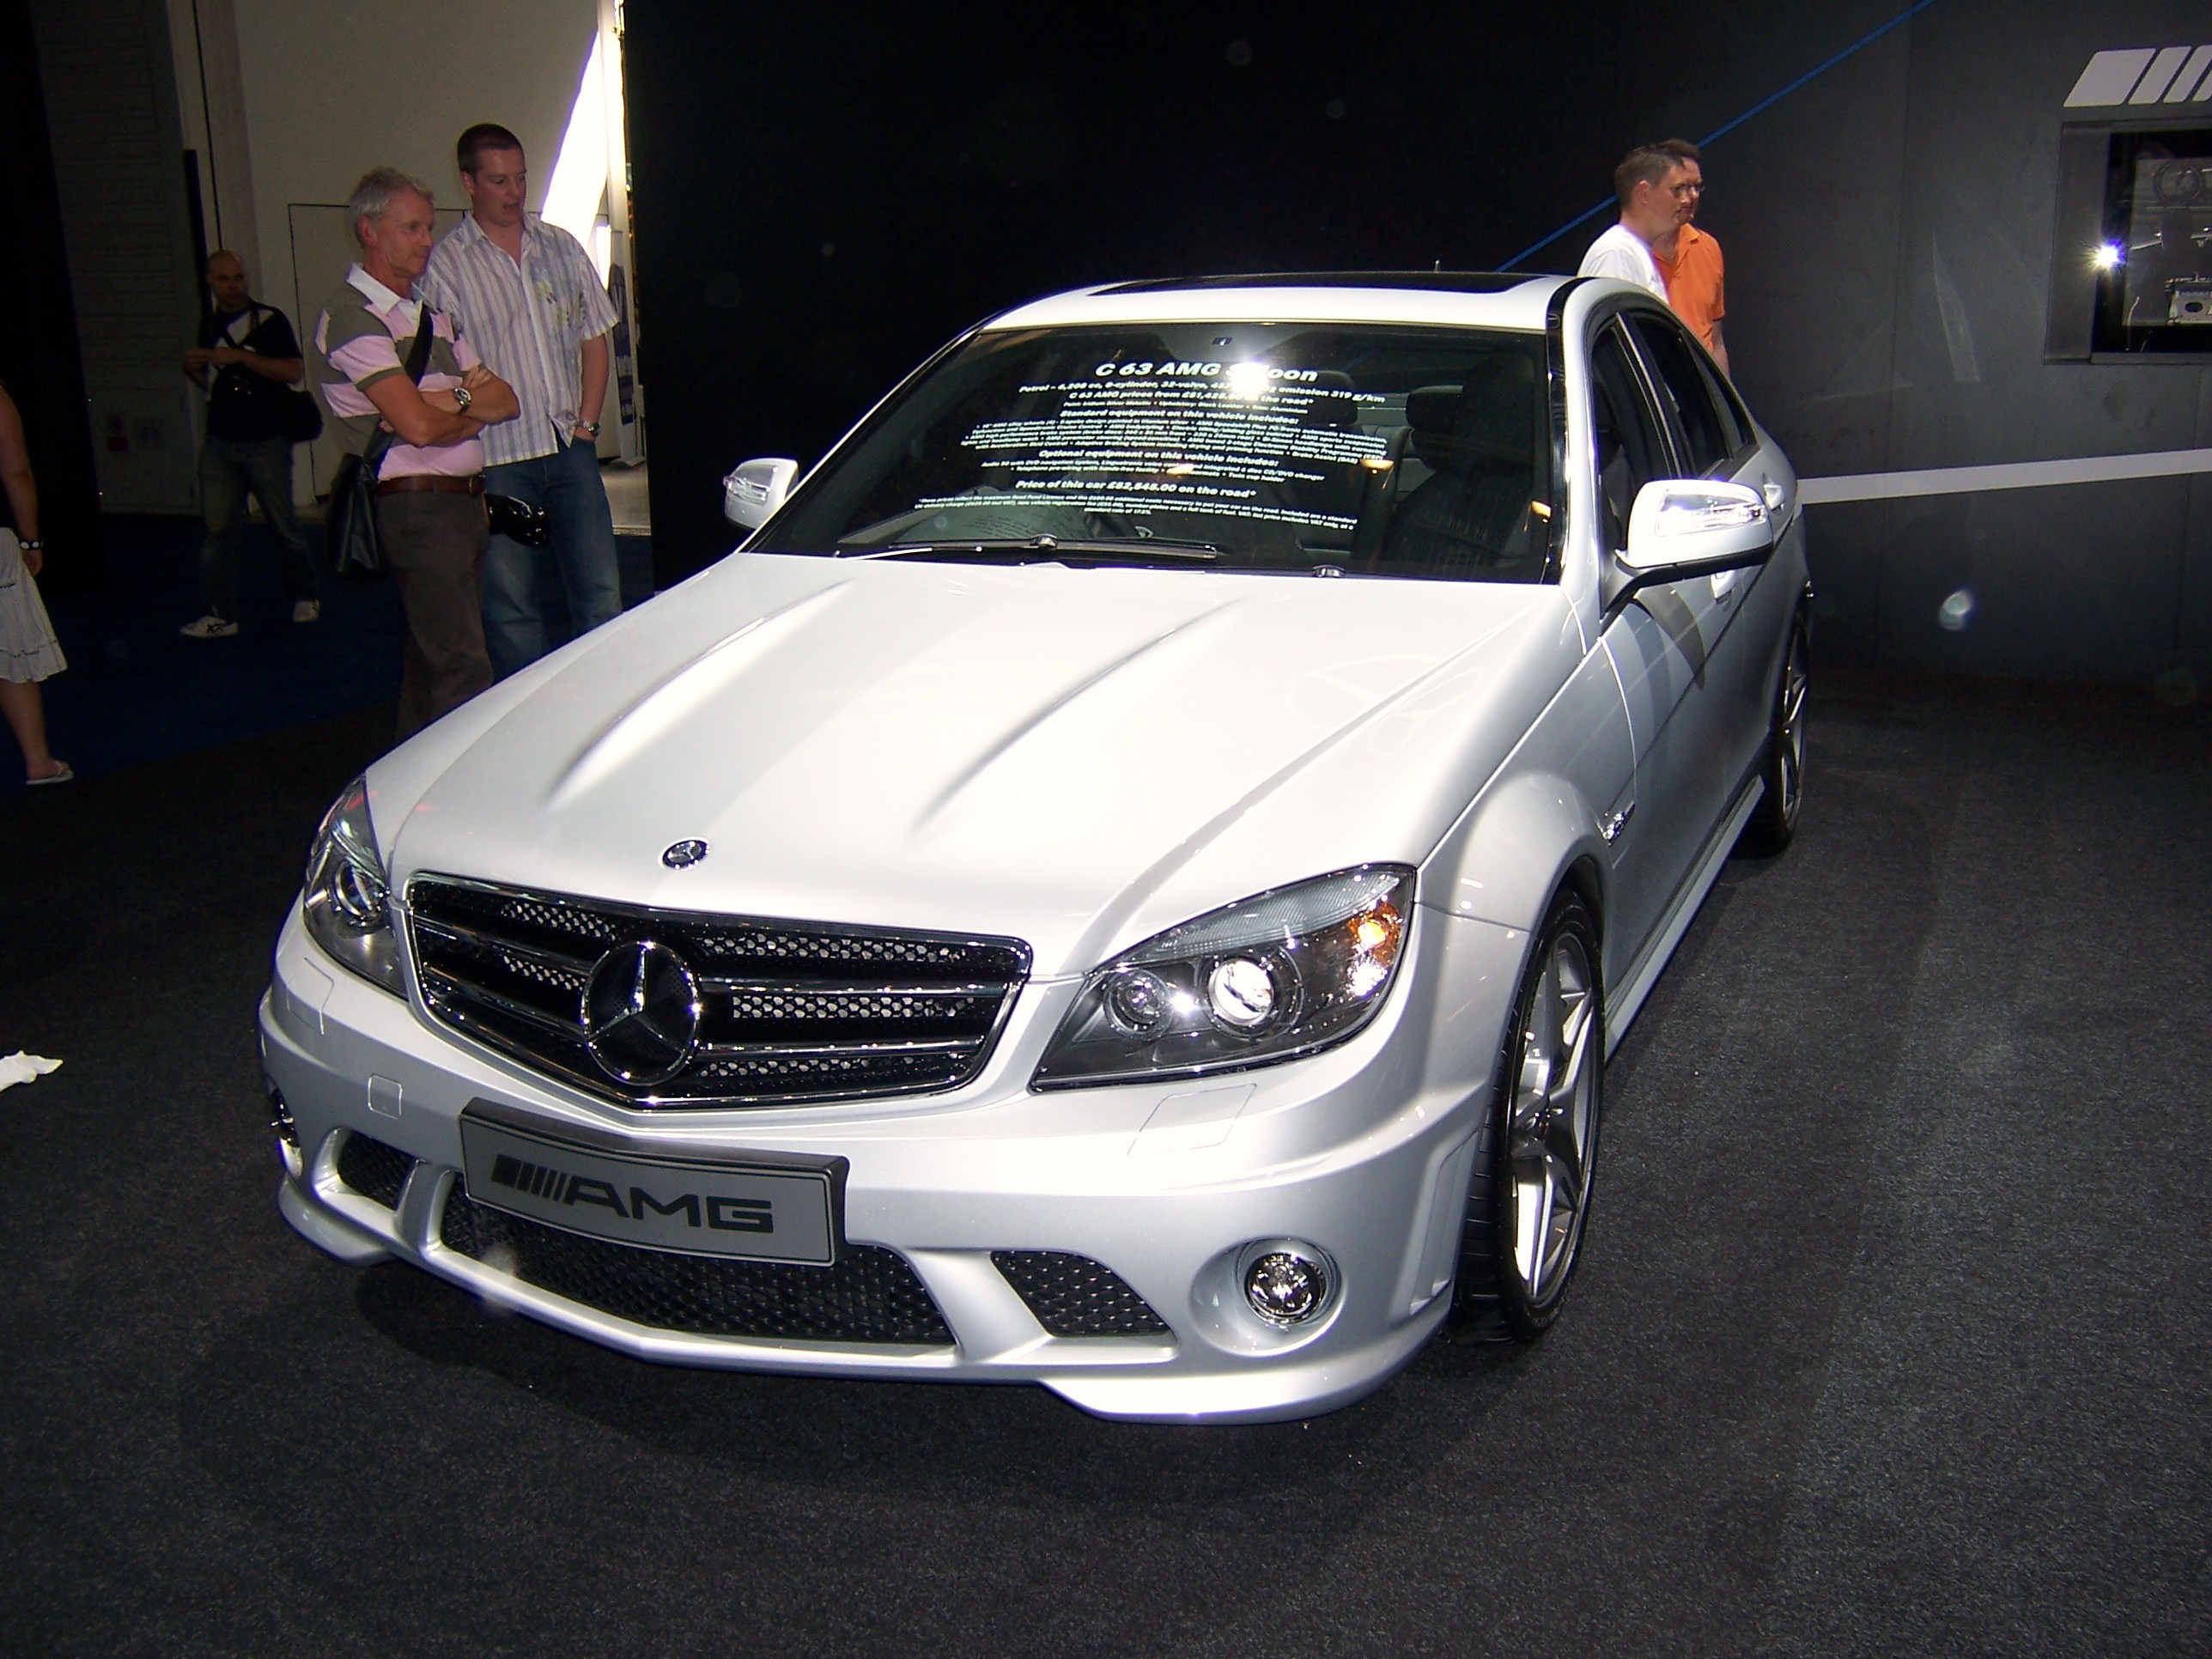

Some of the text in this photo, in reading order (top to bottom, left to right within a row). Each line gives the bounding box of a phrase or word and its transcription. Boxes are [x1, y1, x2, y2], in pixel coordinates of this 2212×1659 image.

[1096, 363, 1115, 376] C
[1119, 362, 1152, 375] 63
[1155, 362, 1221, 375] AMG
[1018, 384, 1050, 392] Petrol
[1279, 386, 1329, 397] emission
[1330, 390, 1352, 399] 319
[1119, 391, 1153, 399] prices
[1060, 409, 1108, 417] Standard
[1108, 410, 1165, 418] equipment
[1182, 410, 1205, 418] this
[1206, 411, 1246, 421] vehicle
[1247, 413, 1298, 425] includes:
[1039, 449, 1084, 459] Optional
[1085, 449, 1143, 459] equipment
[1160, 451, 1182, 459] this
[1183, 453, 1224, 462] vehicle
[1225, 455, 1279, 467] includes:
[1016, 480, 1045, 489] Price
[1047, 480, 1061, 489] of
[1061, 480, 1085, 489] this
[1196, 486, 1218, 495] the
[564, 1175, 774, 1234] AMG
